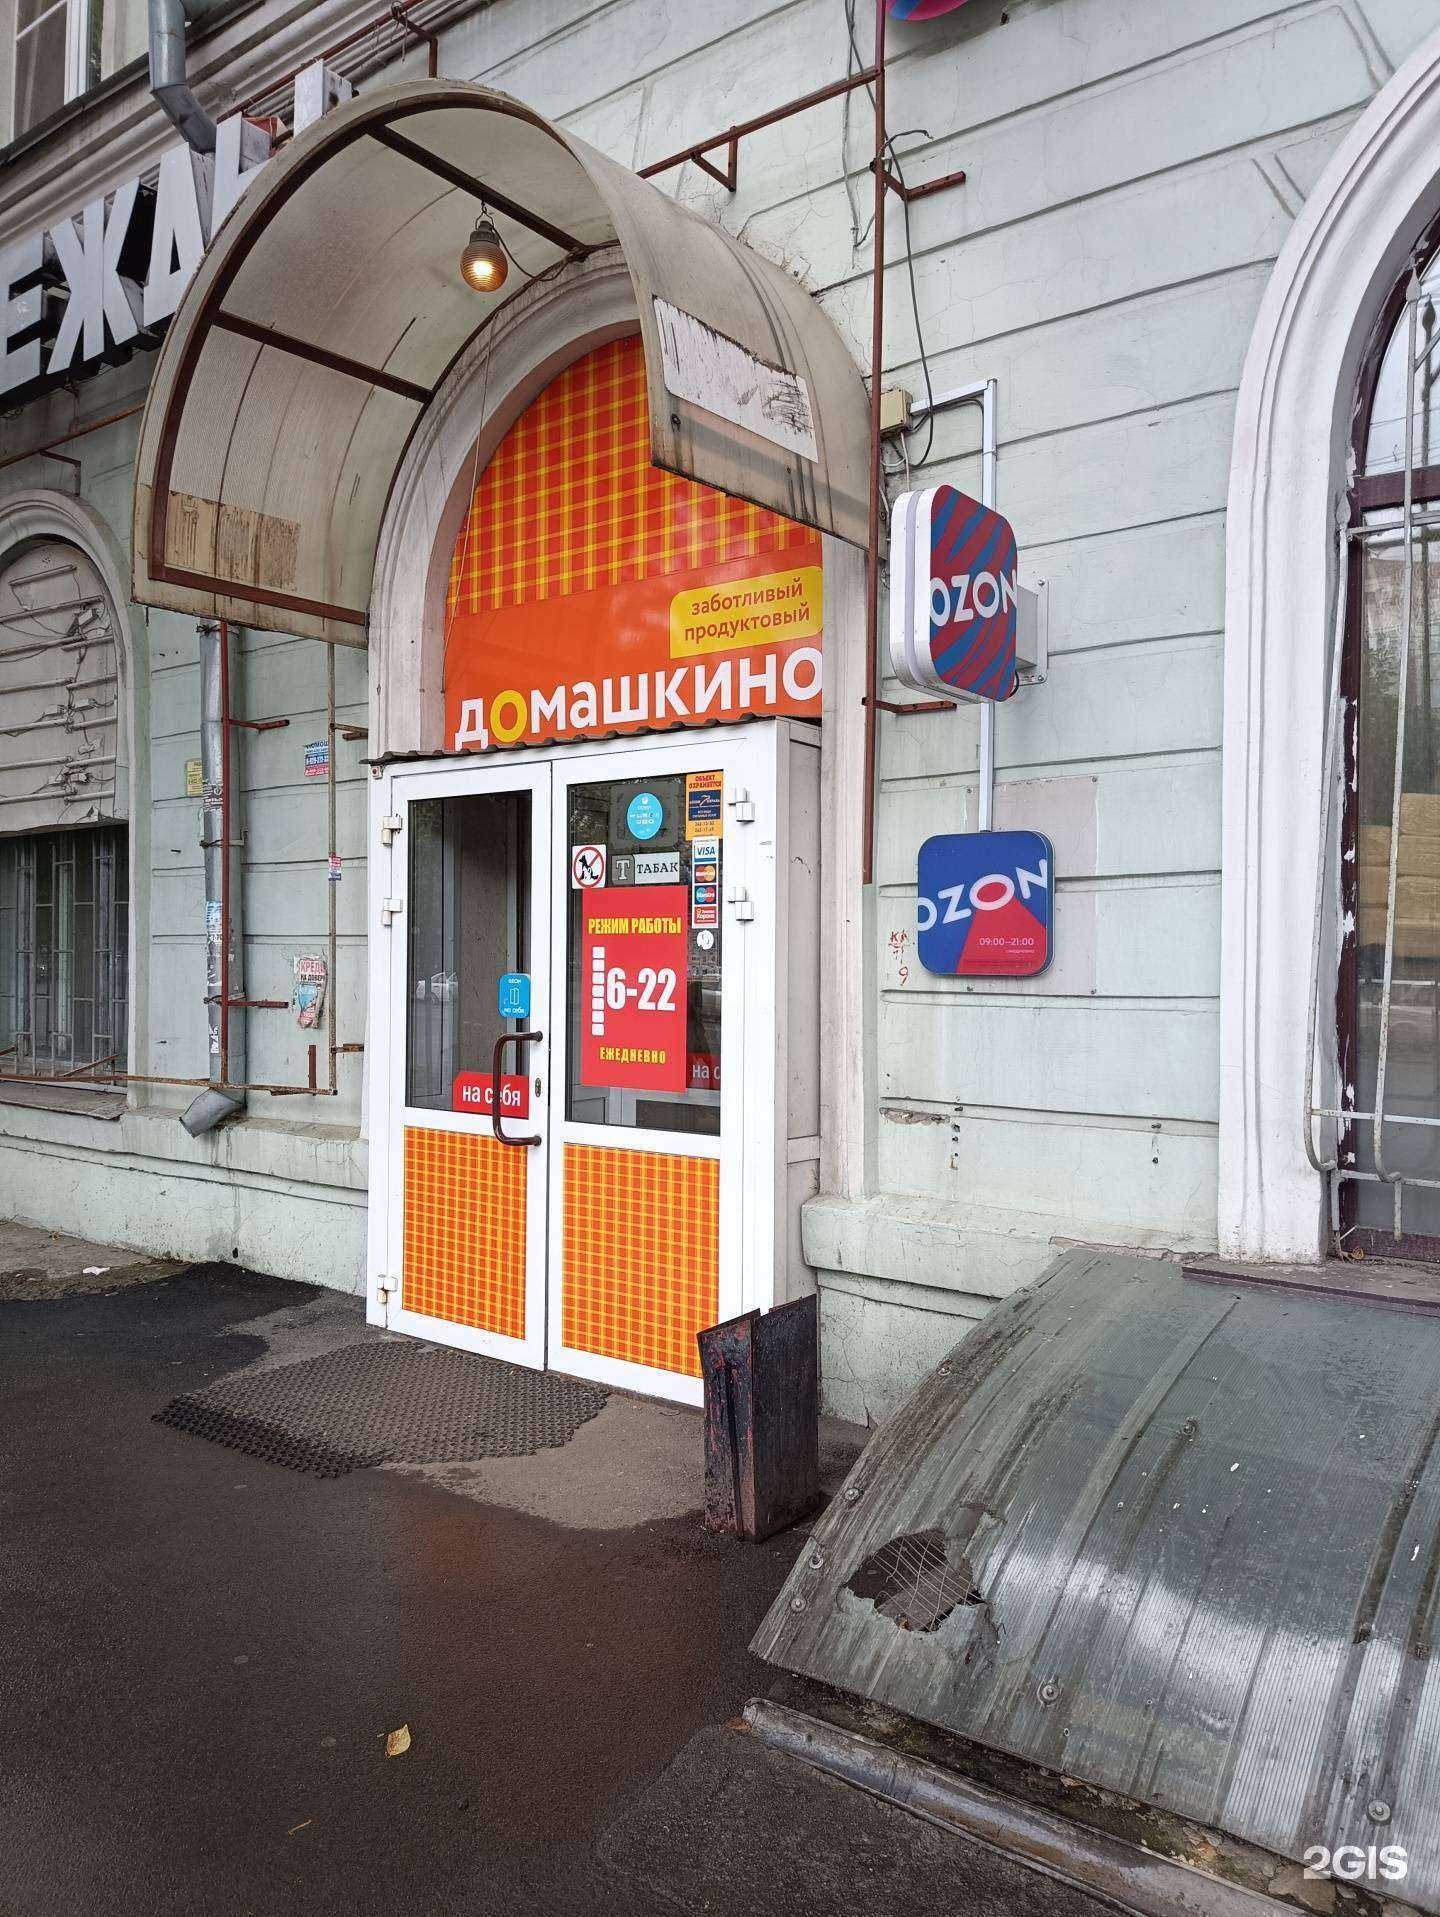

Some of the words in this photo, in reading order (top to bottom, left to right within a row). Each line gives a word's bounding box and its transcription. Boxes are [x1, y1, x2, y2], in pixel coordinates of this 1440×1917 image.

[691, 576, 804, 617] заботливый
[930, 569, 1018, 627] OZON
[684, 602, 810, 643] продуктовый
[697, 846, 716, 856] VISA
[636, 862, 679, 875] ТАБАК
[588, 918, 629, 935] РЕЖИМ
[631, 916, 682, 934] РАБОТЫ
[606, 967, 677, 1011] 6-22
[599, 1047, 666, 1064] ЕЖЕДНЕВНО
[692, 1064, 710, 1079] на
[463, 1086, 480, 1103] на
[485, 1084, 520, 1107] сбя
